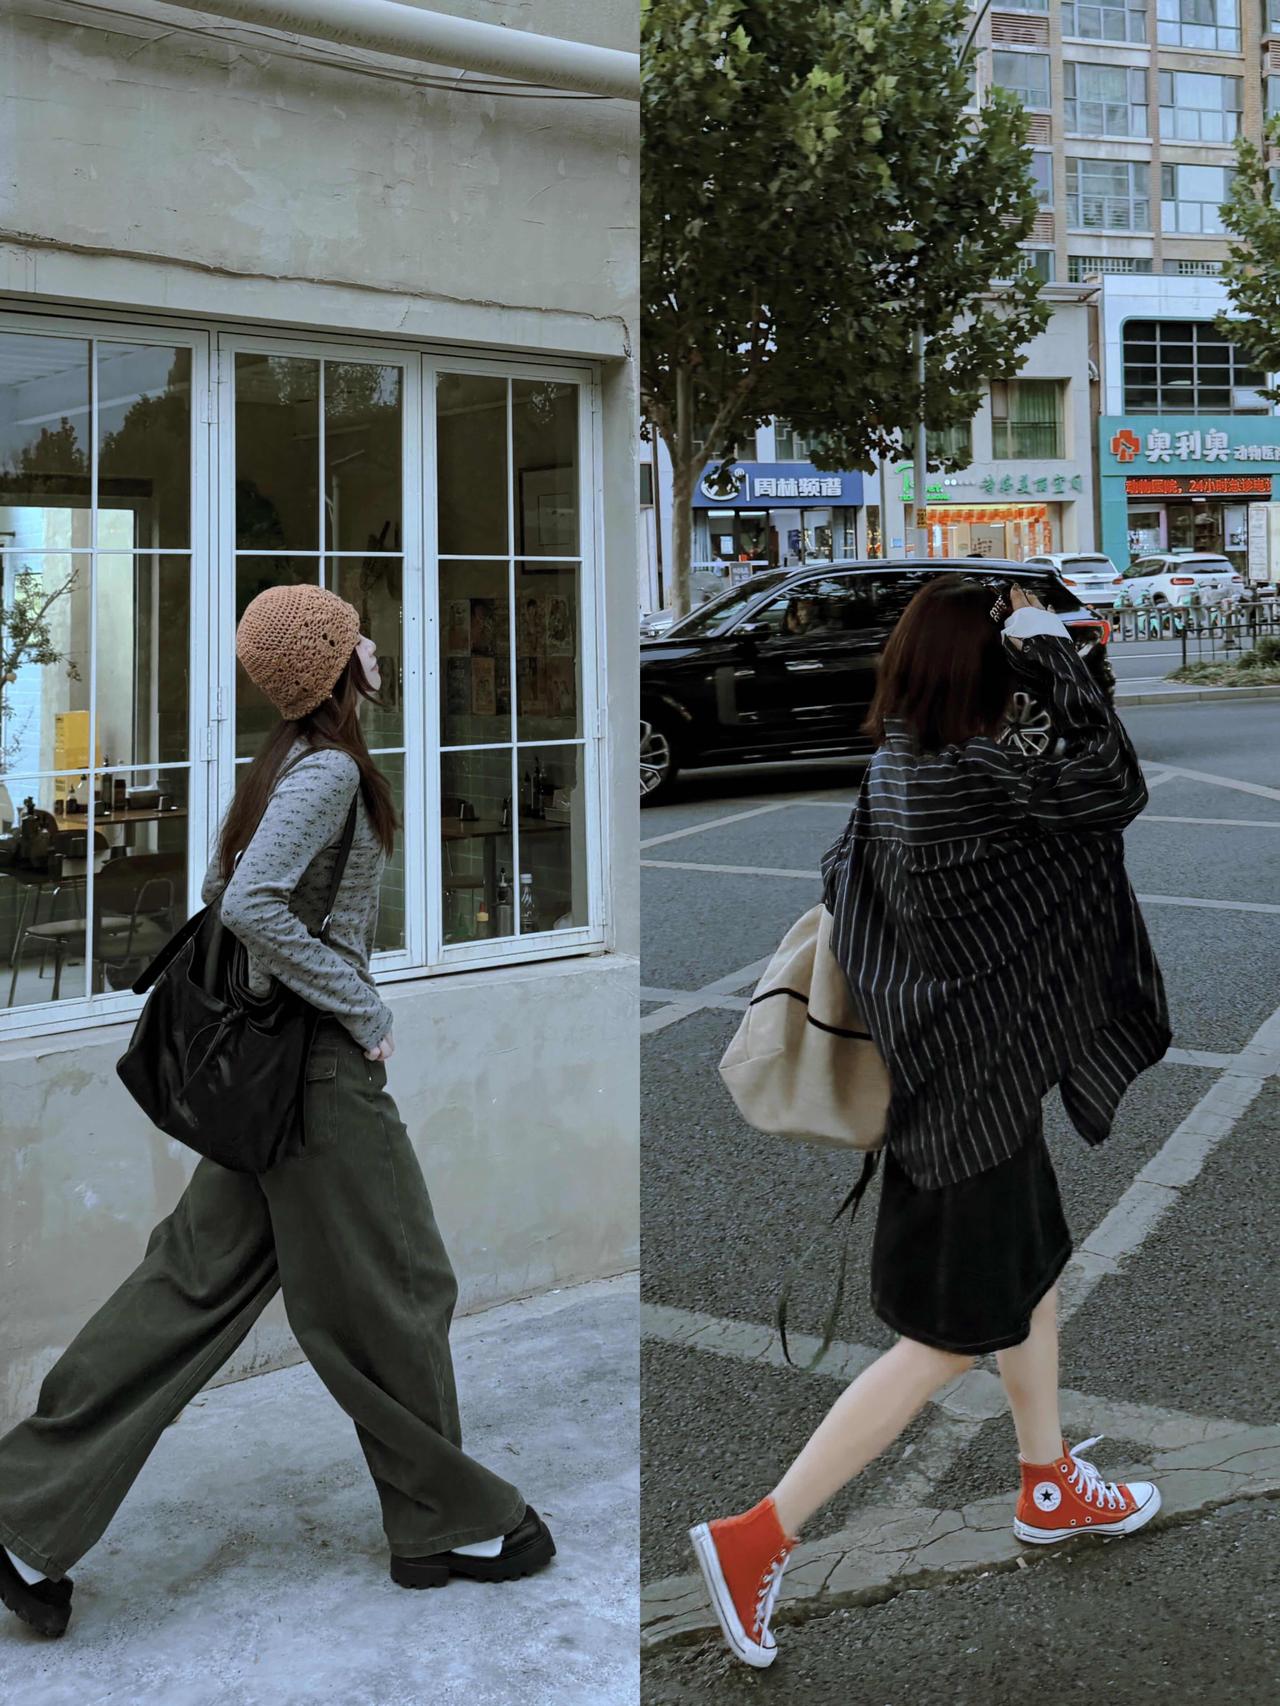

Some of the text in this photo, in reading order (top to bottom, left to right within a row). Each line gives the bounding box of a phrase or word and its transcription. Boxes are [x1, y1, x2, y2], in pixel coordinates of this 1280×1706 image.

[1145, 428, 1231, 463] 奥利奥
[754, 477, 842, 497] 周林频谱
